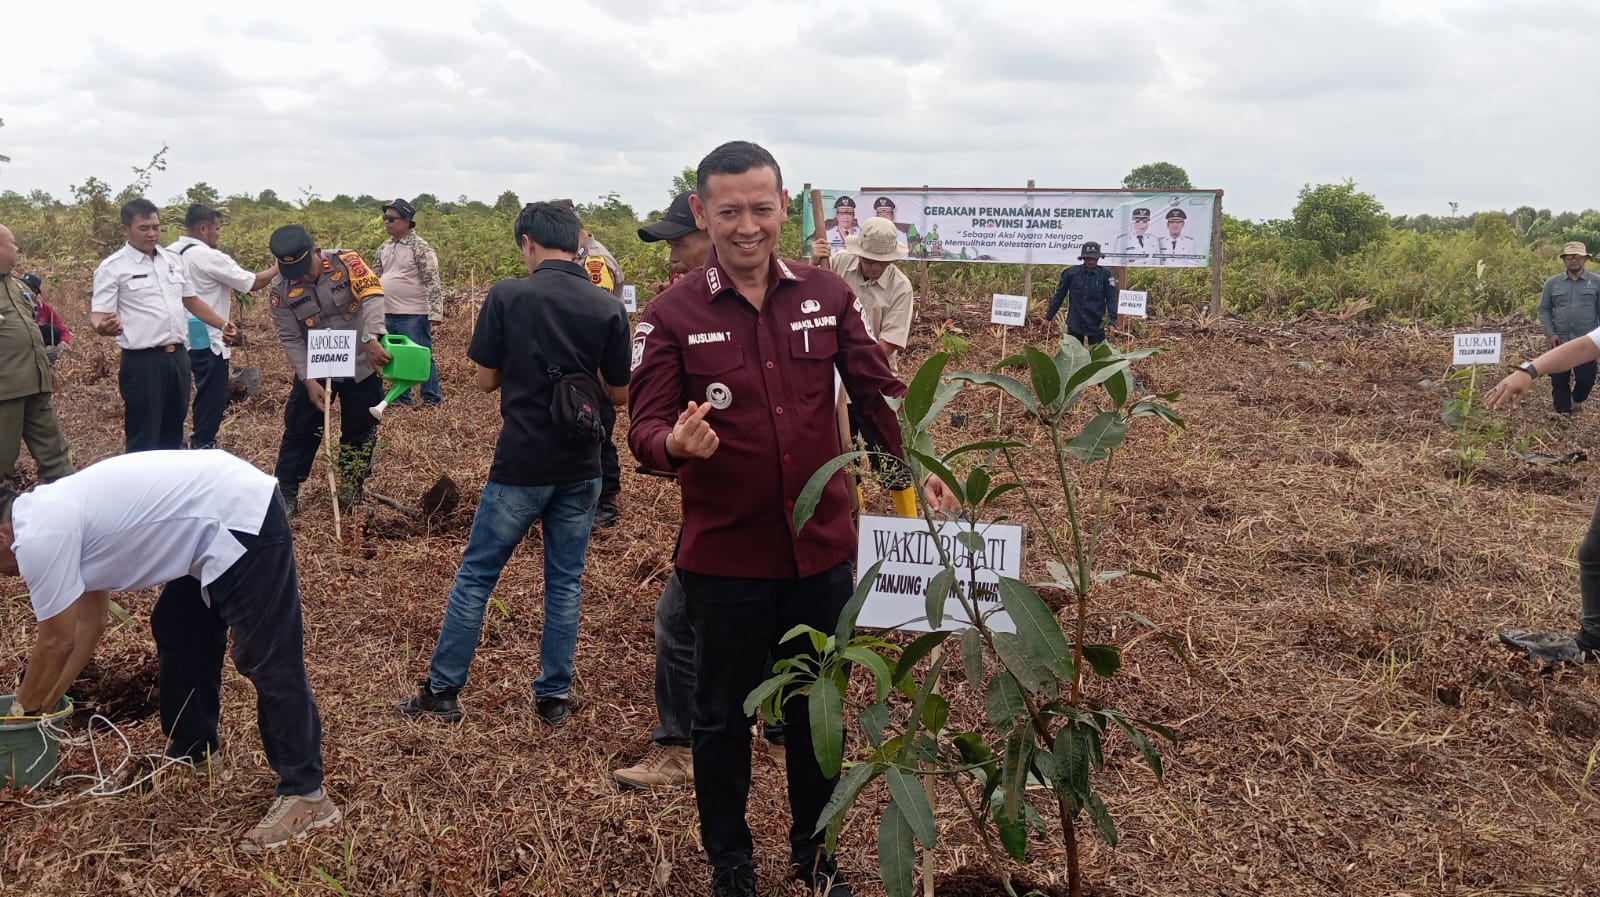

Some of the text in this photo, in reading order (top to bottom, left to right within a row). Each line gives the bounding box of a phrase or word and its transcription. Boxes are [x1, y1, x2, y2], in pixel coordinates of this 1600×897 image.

[924, 206, 1114, 219] GERAKAN PENANAMAN SERENTAK
[972, 218, 1023, 229] PROVINSI
[998, 231, 1015, 239] Aksi
[1017, 232, 1043, 242] Nyata
[1044, 232, 1084, 242] Menjaga
[998, 240, 1047, 249] Kelestarian
[790, 320, 814, 332] WAKIL
[310, 335, 350, 350] KAPOLSEK
[688, 331, 732, 345] MUSLIMIN T
[1458, 336, 1496, 346] LURAH
[311, 353, 348, 363] DENDANG
[873, 529, 934, 565] WAKIL
[875, 573, 922, 596] TANJUNG
